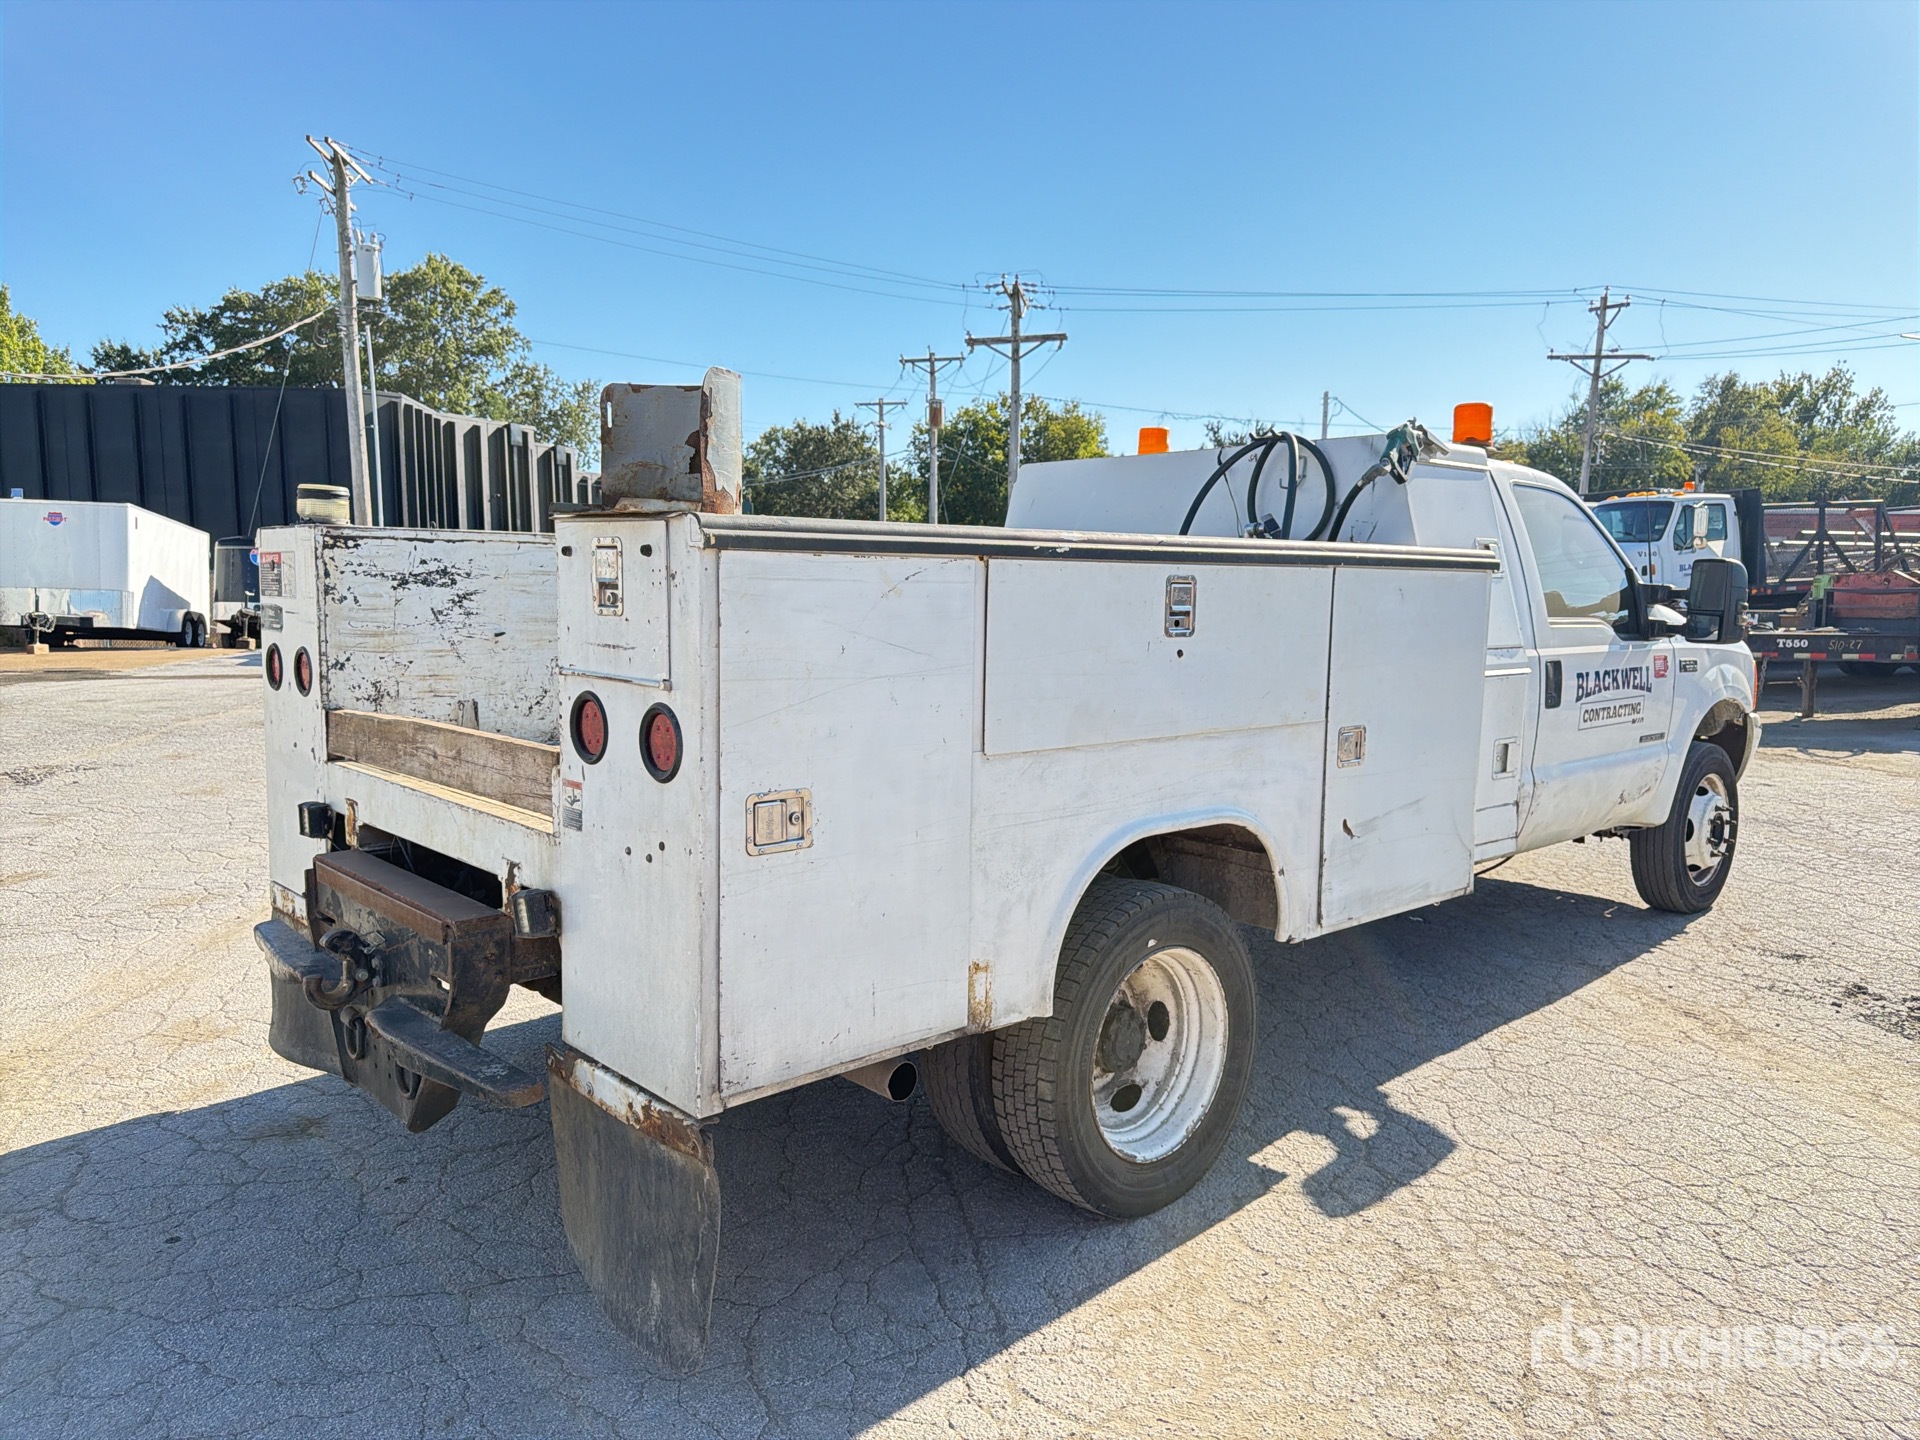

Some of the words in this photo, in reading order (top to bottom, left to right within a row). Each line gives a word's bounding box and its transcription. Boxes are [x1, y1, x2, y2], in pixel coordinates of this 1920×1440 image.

[1776, 638, 1808, 648] T550
[1575, 666, 1652, 702] BLACKWELL
[1583, 702, 1642, 723] CONTRACTING
